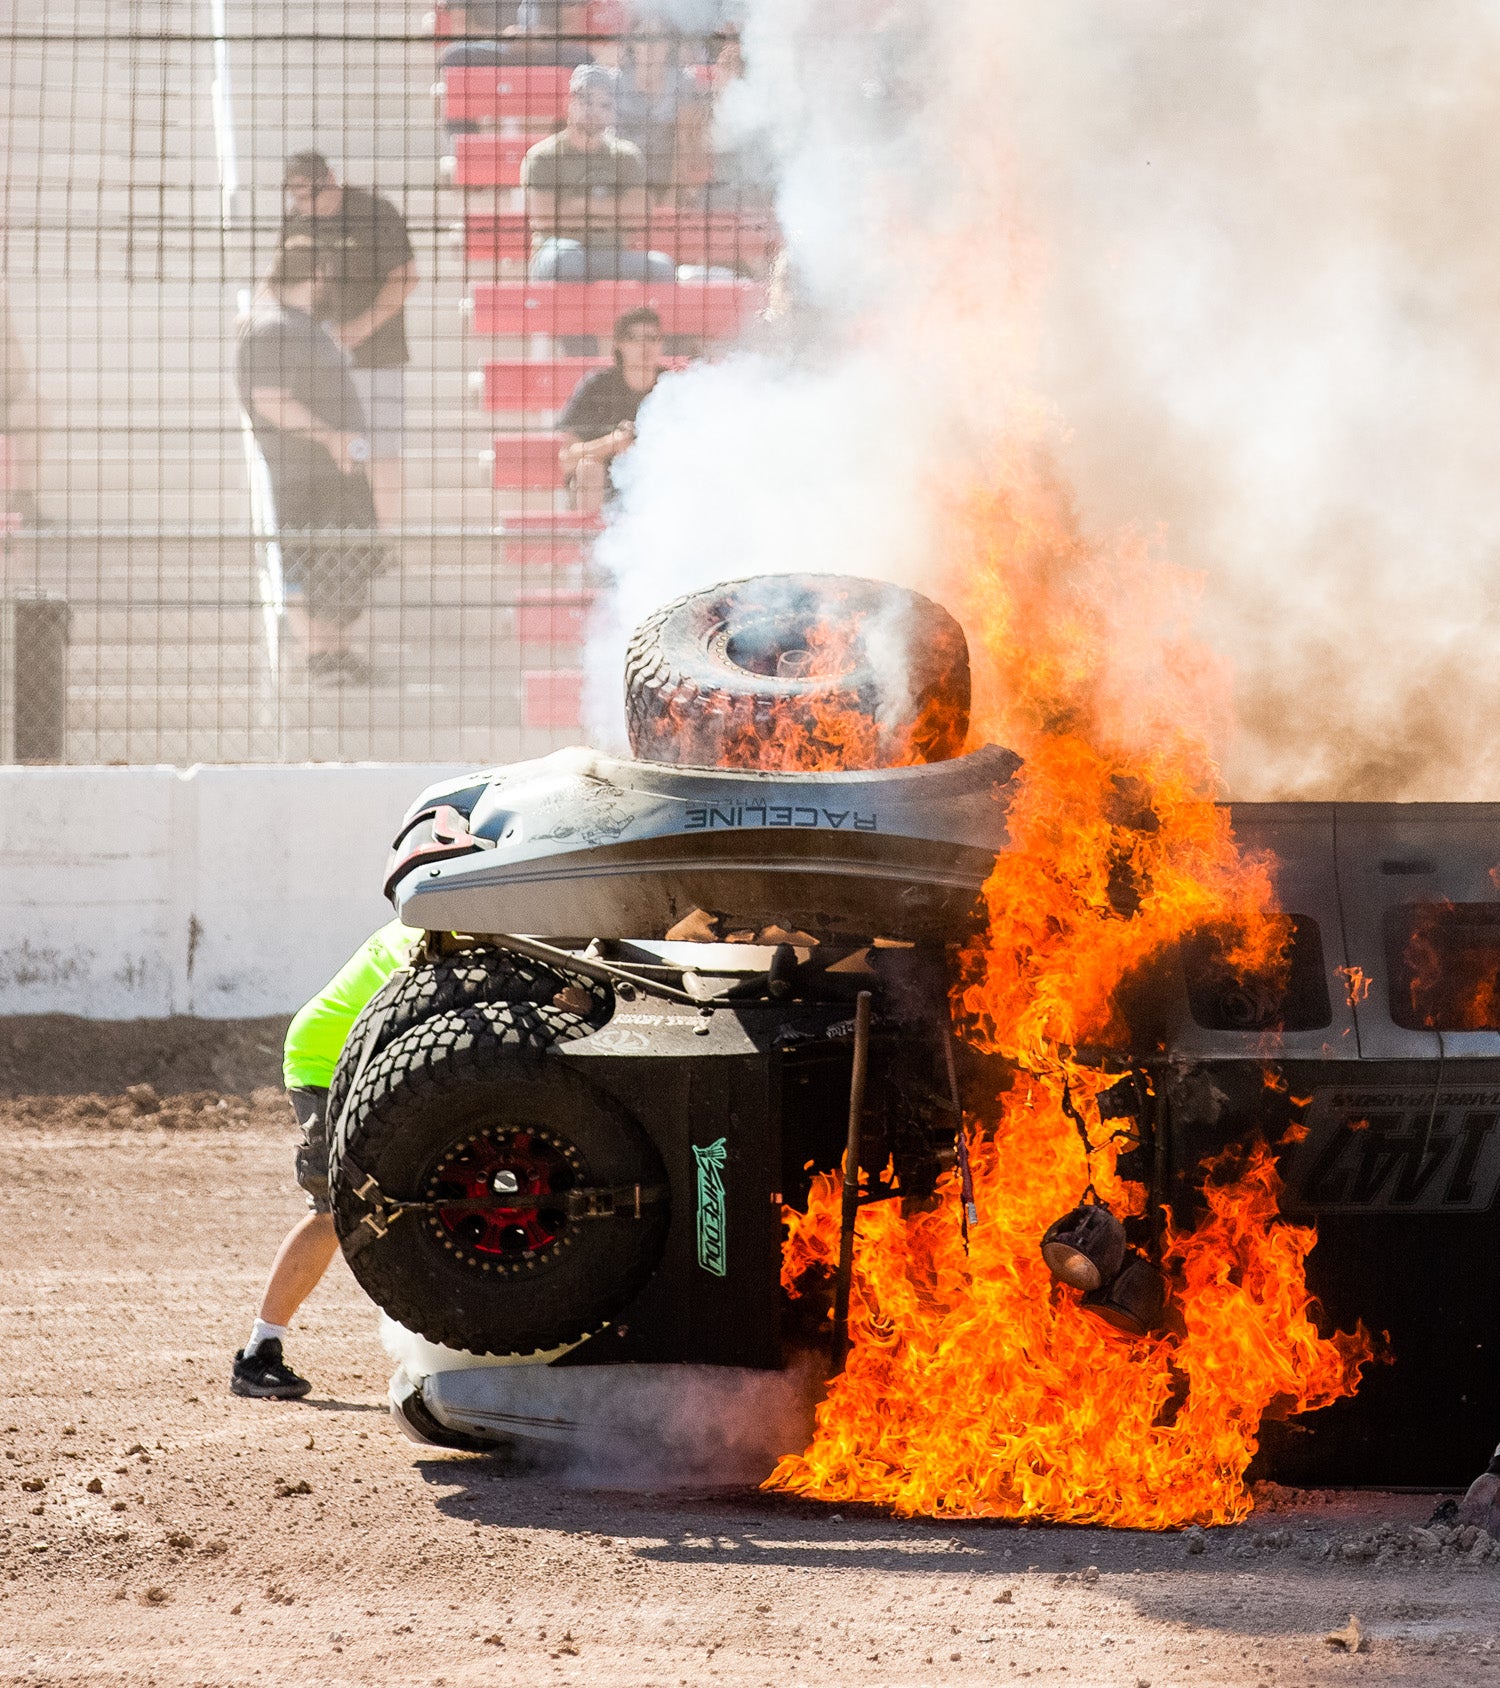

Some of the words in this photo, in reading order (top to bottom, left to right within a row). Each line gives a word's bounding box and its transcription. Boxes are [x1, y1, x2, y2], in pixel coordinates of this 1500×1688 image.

[684, 807, 878, 830] RACELINE
[685, 797, 766, 807] WHE
[1306, 1113, 1499, 1205] 1447
[697, 1157, 725, 1274] SHREDDY
